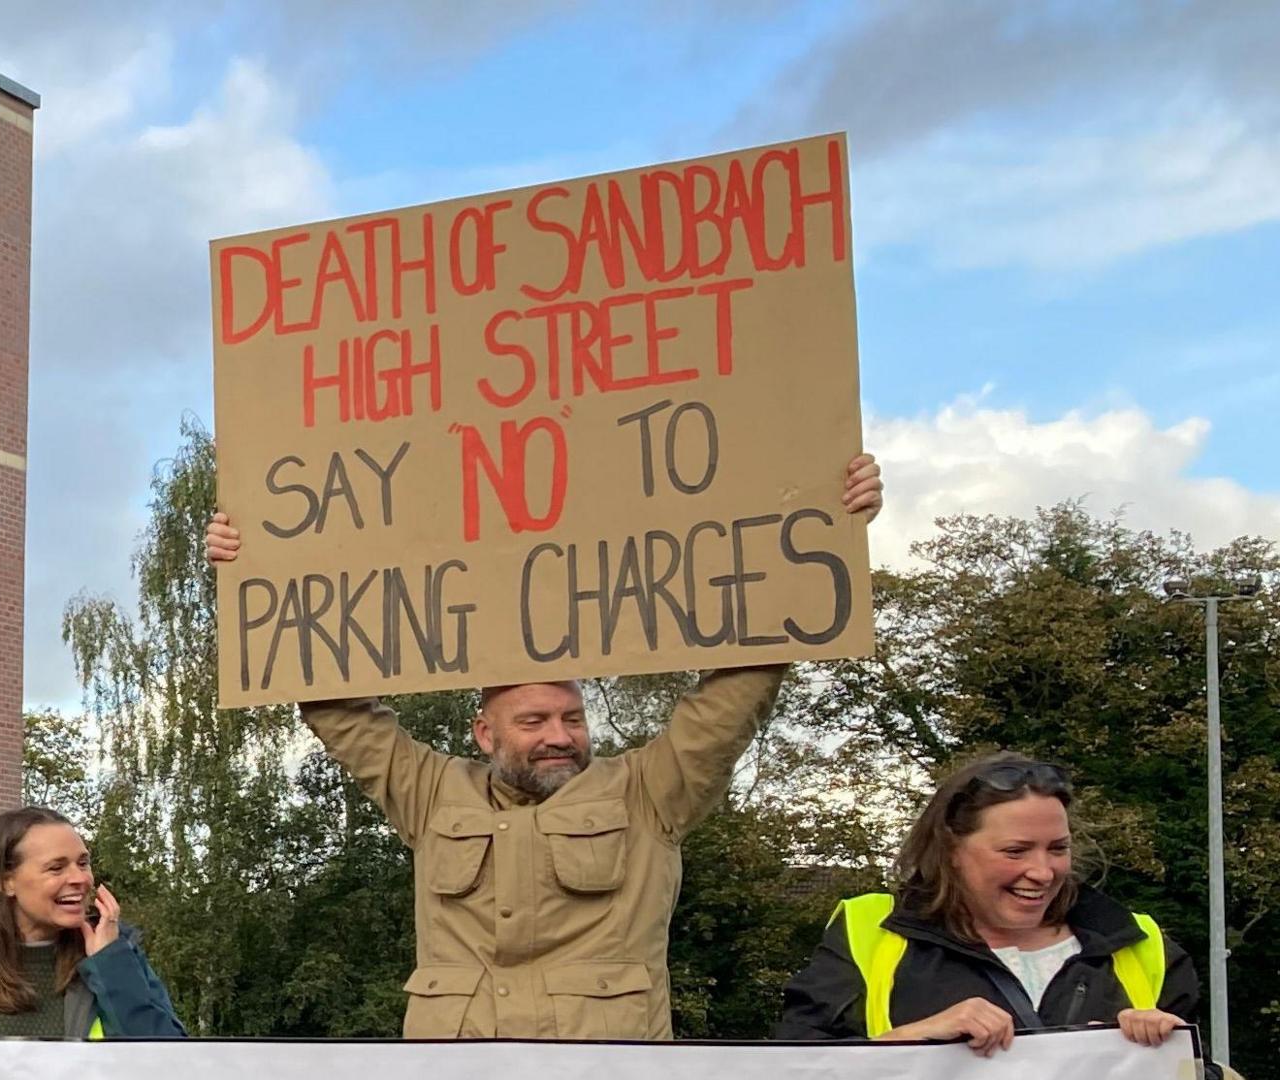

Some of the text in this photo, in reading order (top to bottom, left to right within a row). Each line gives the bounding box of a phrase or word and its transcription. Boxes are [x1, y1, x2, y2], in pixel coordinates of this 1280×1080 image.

[219, 140, 846, 344] DEATH OF SANDBACH
[303, 278, 754, 427] HIGH STREET
[262, 441, 411, 538] SAY
[618, 400, 719, 497] TO
[238, 509, 852, 690] PARKING CHARGES
